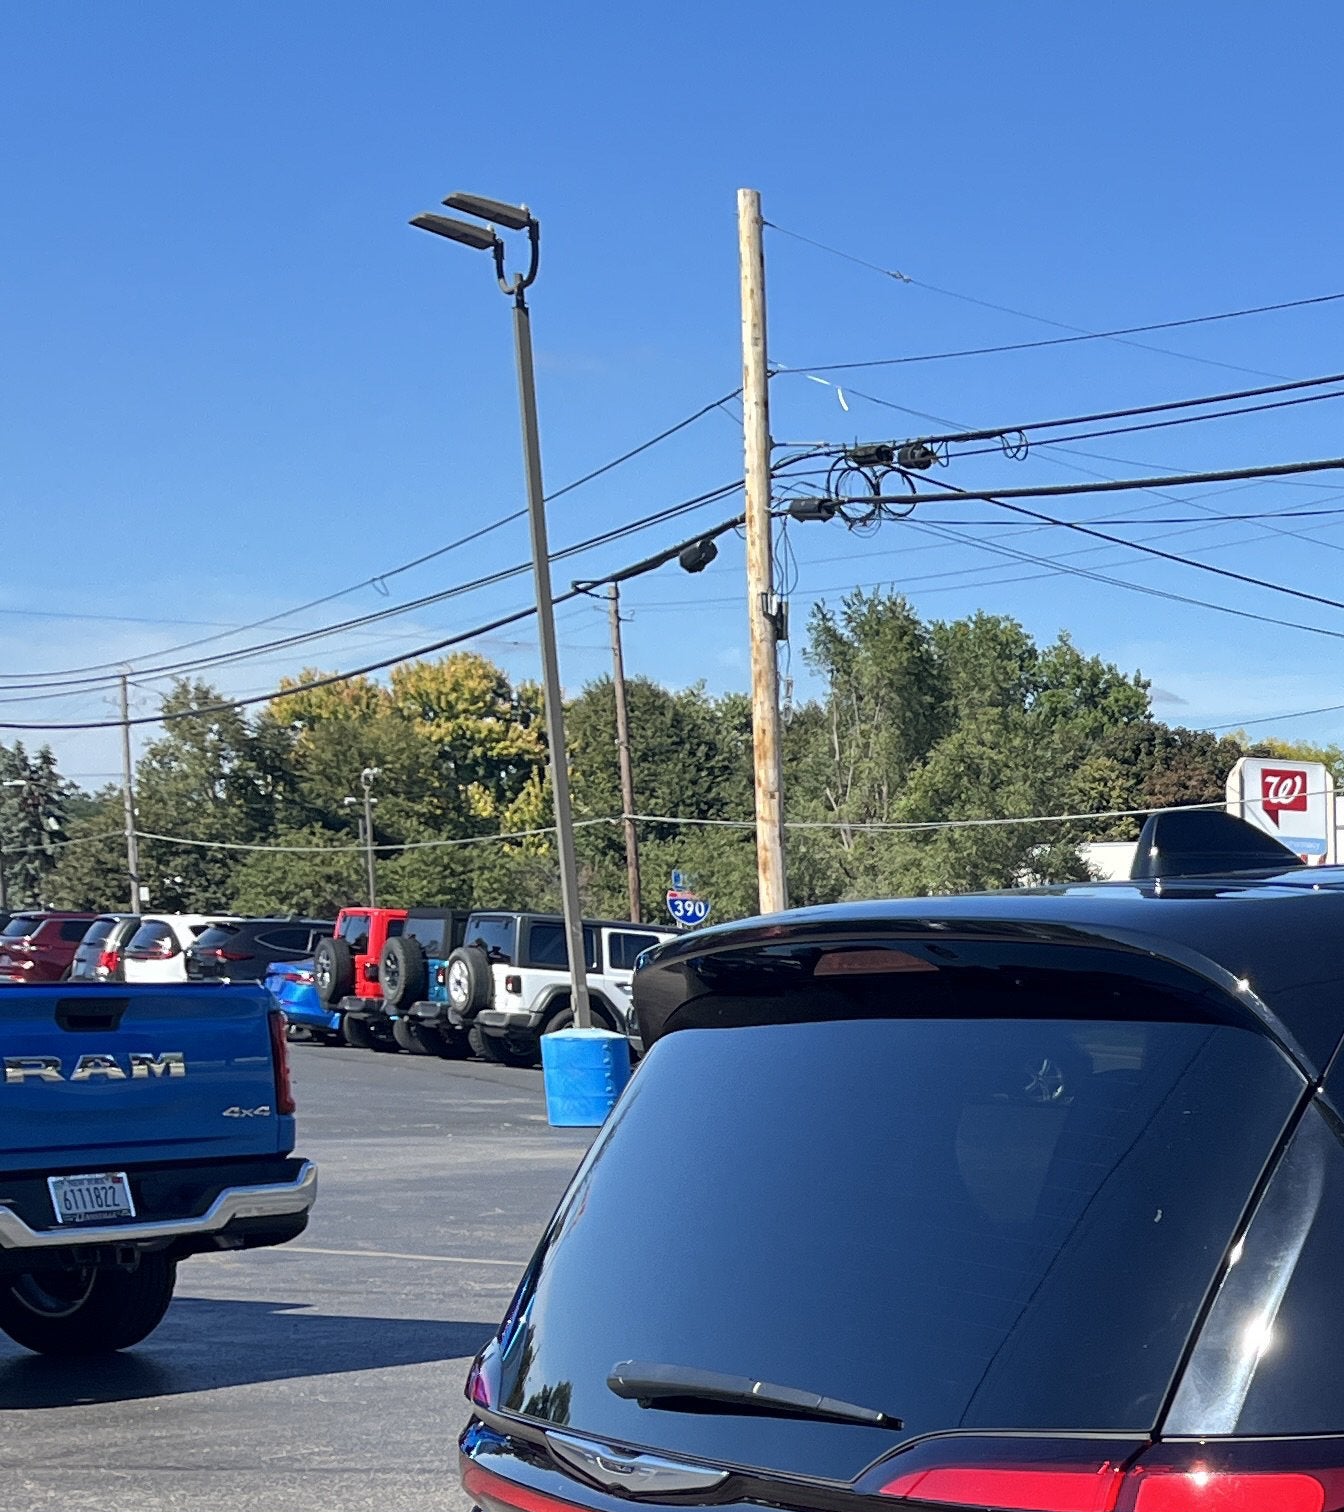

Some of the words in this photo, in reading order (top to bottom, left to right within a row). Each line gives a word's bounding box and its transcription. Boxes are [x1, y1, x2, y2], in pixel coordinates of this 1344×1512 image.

[673, 900, 705, 917] 390
[3, 1052, 186, 1083] RAM
[63, 1185, 120, 1210] 6111822
